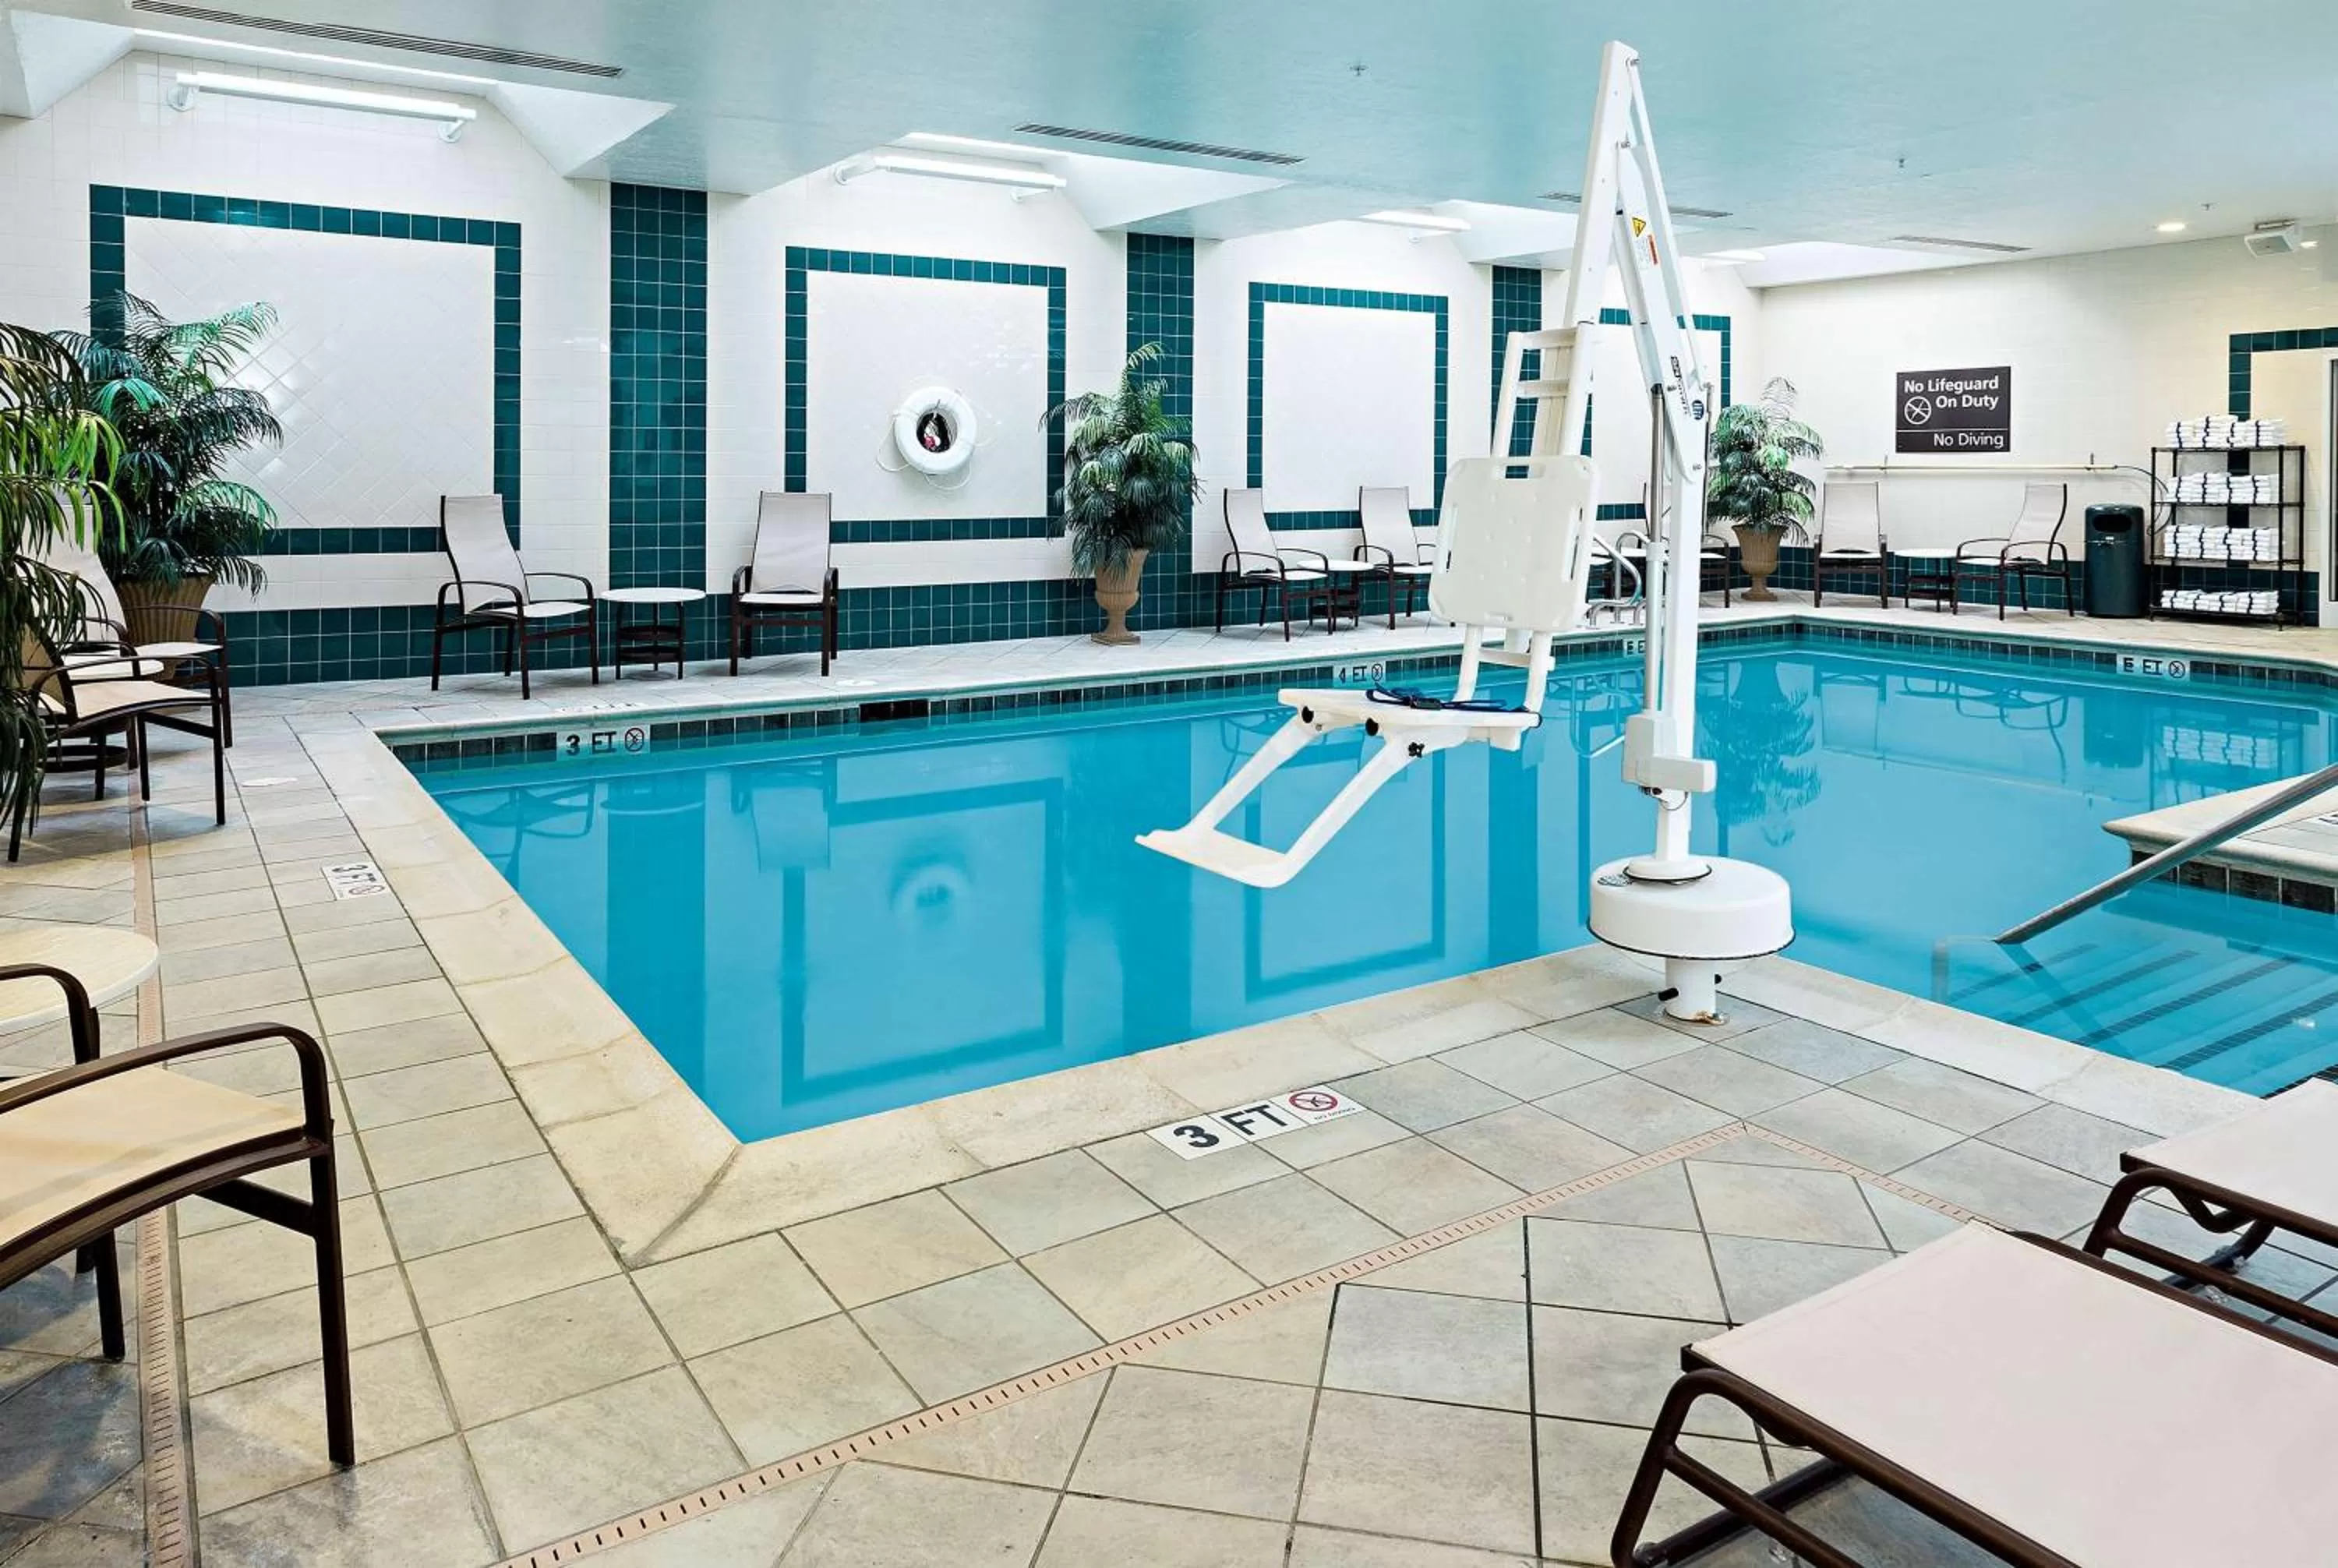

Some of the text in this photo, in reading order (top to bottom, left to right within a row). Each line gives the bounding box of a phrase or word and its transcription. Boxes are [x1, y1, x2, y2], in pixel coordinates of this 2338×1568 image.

[1904, 376, 1999, 394] No Lifeguard
[1935, 394, 1999, 410] On Duty
[1934, 432, 2004, 448] No Diving
[566, 734, 581, 755] 3
[1173, 1125, 1220, 1148] 3
[1220, 1104, 1288, 1135] FT
